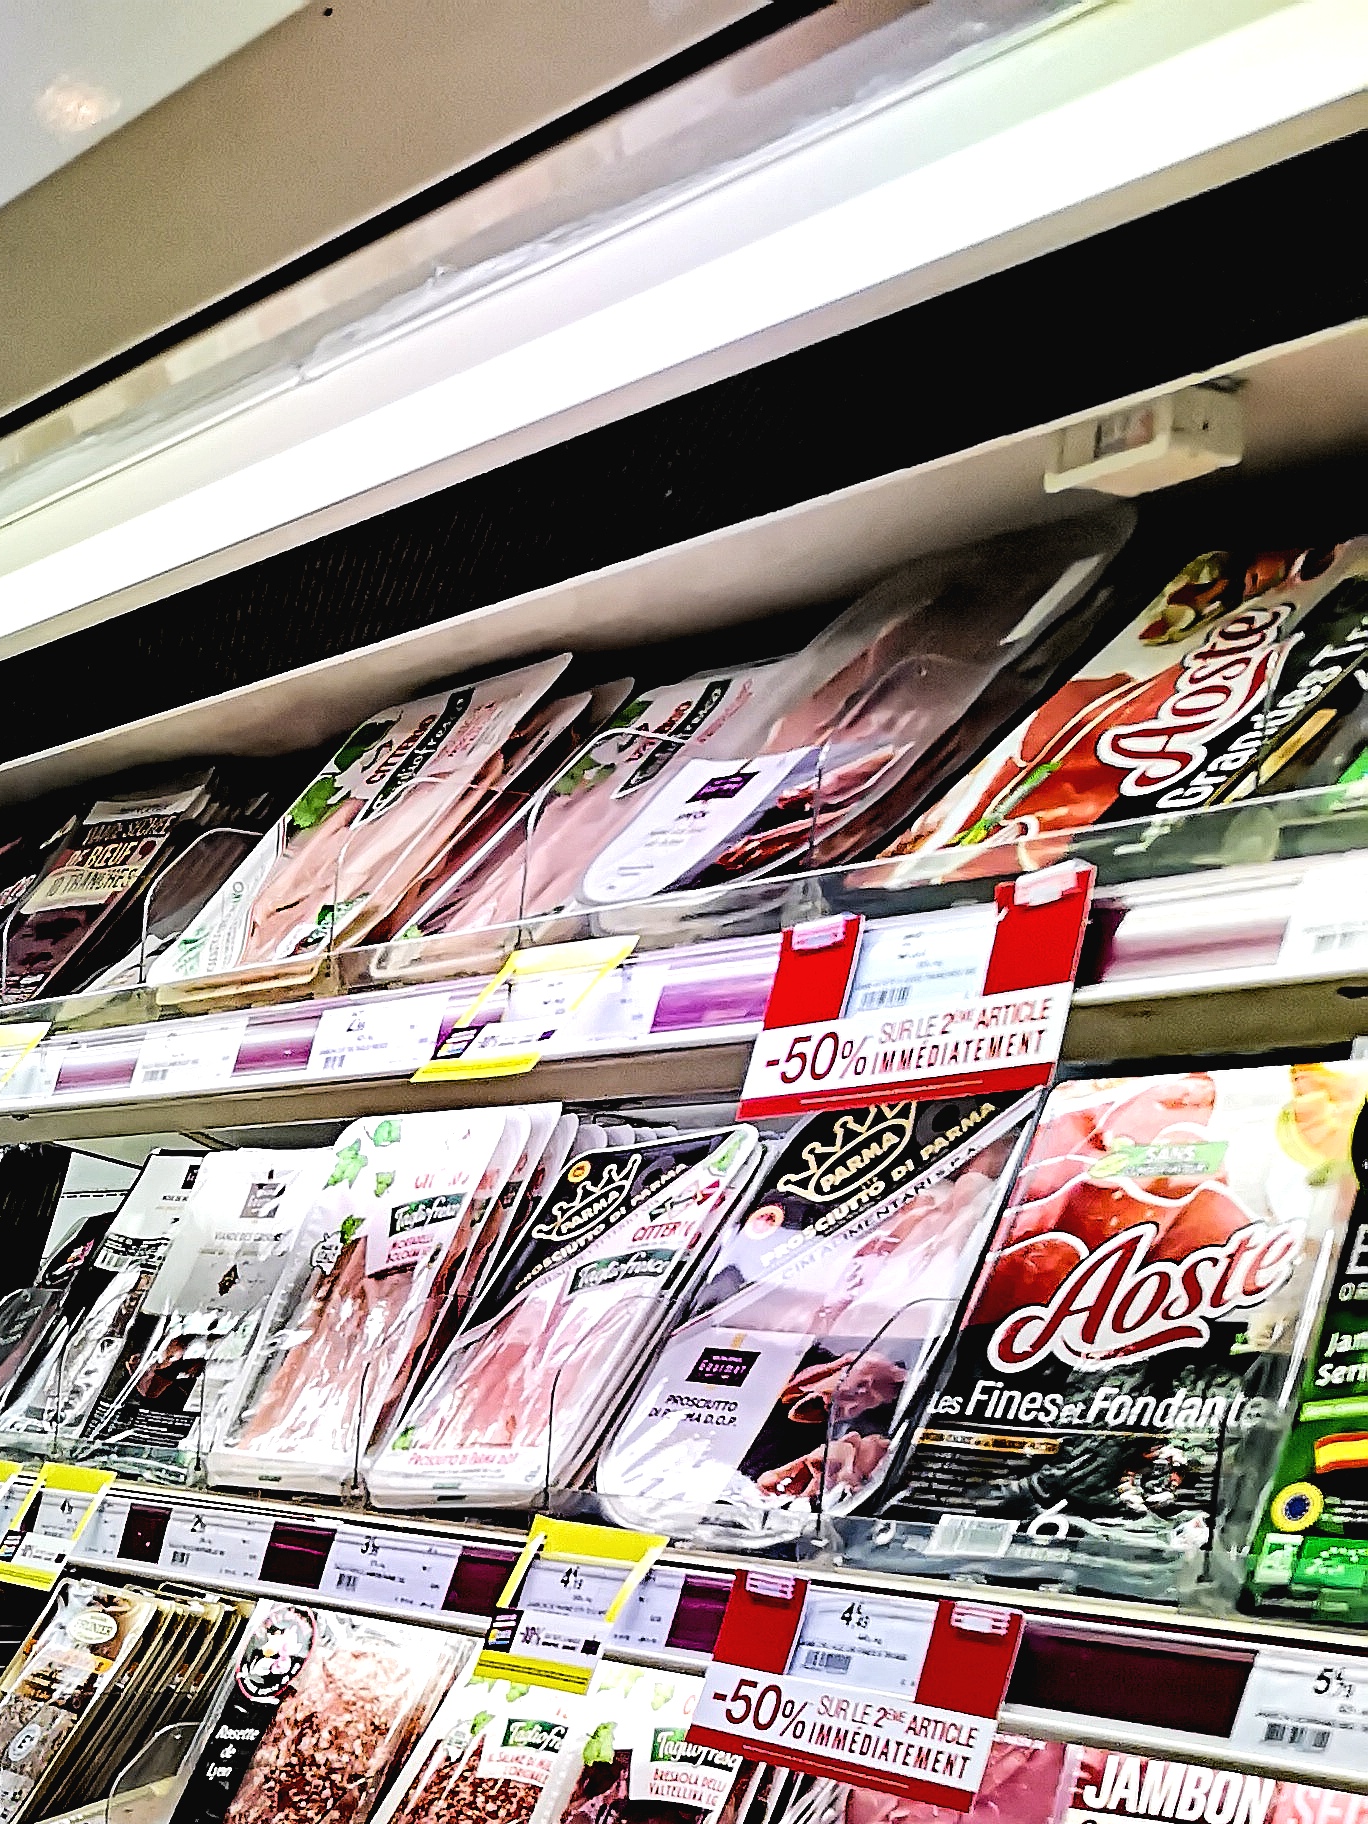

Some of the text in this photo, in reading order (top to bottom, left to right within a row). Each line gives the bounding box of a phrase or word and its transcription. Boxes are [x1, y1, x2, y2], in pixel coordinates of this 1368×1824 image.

[1102, 607, 1287, 792] Aoste
[1156, 665, 1342, 807] Grandes
[880, 998, 1053, 1044] SUR LE ARTICLE
[766, 1030, 873, 1084] -50%
[871, 1029, 1047, 1076] IMMÉDIATEMENT
[760, 1102, 997, 1268] PROSCIUTTO DI PARMA
[819, 1131, 901, 1193] PARMA
[561, 1189, 621, 1233] PARMA
[993, 1222, 1301, 1369] Aoste
[665, 1394, 739, 1412] PROSCIUTTO
[965, 1379, 1064, 1424] Fines
[713, 1678, 807, 1739] -50%
[817, 1695, 978, 1748] SUR LE ARTICLE
[809, 1720, 970, 1779] IMMÉDIATEMENT
